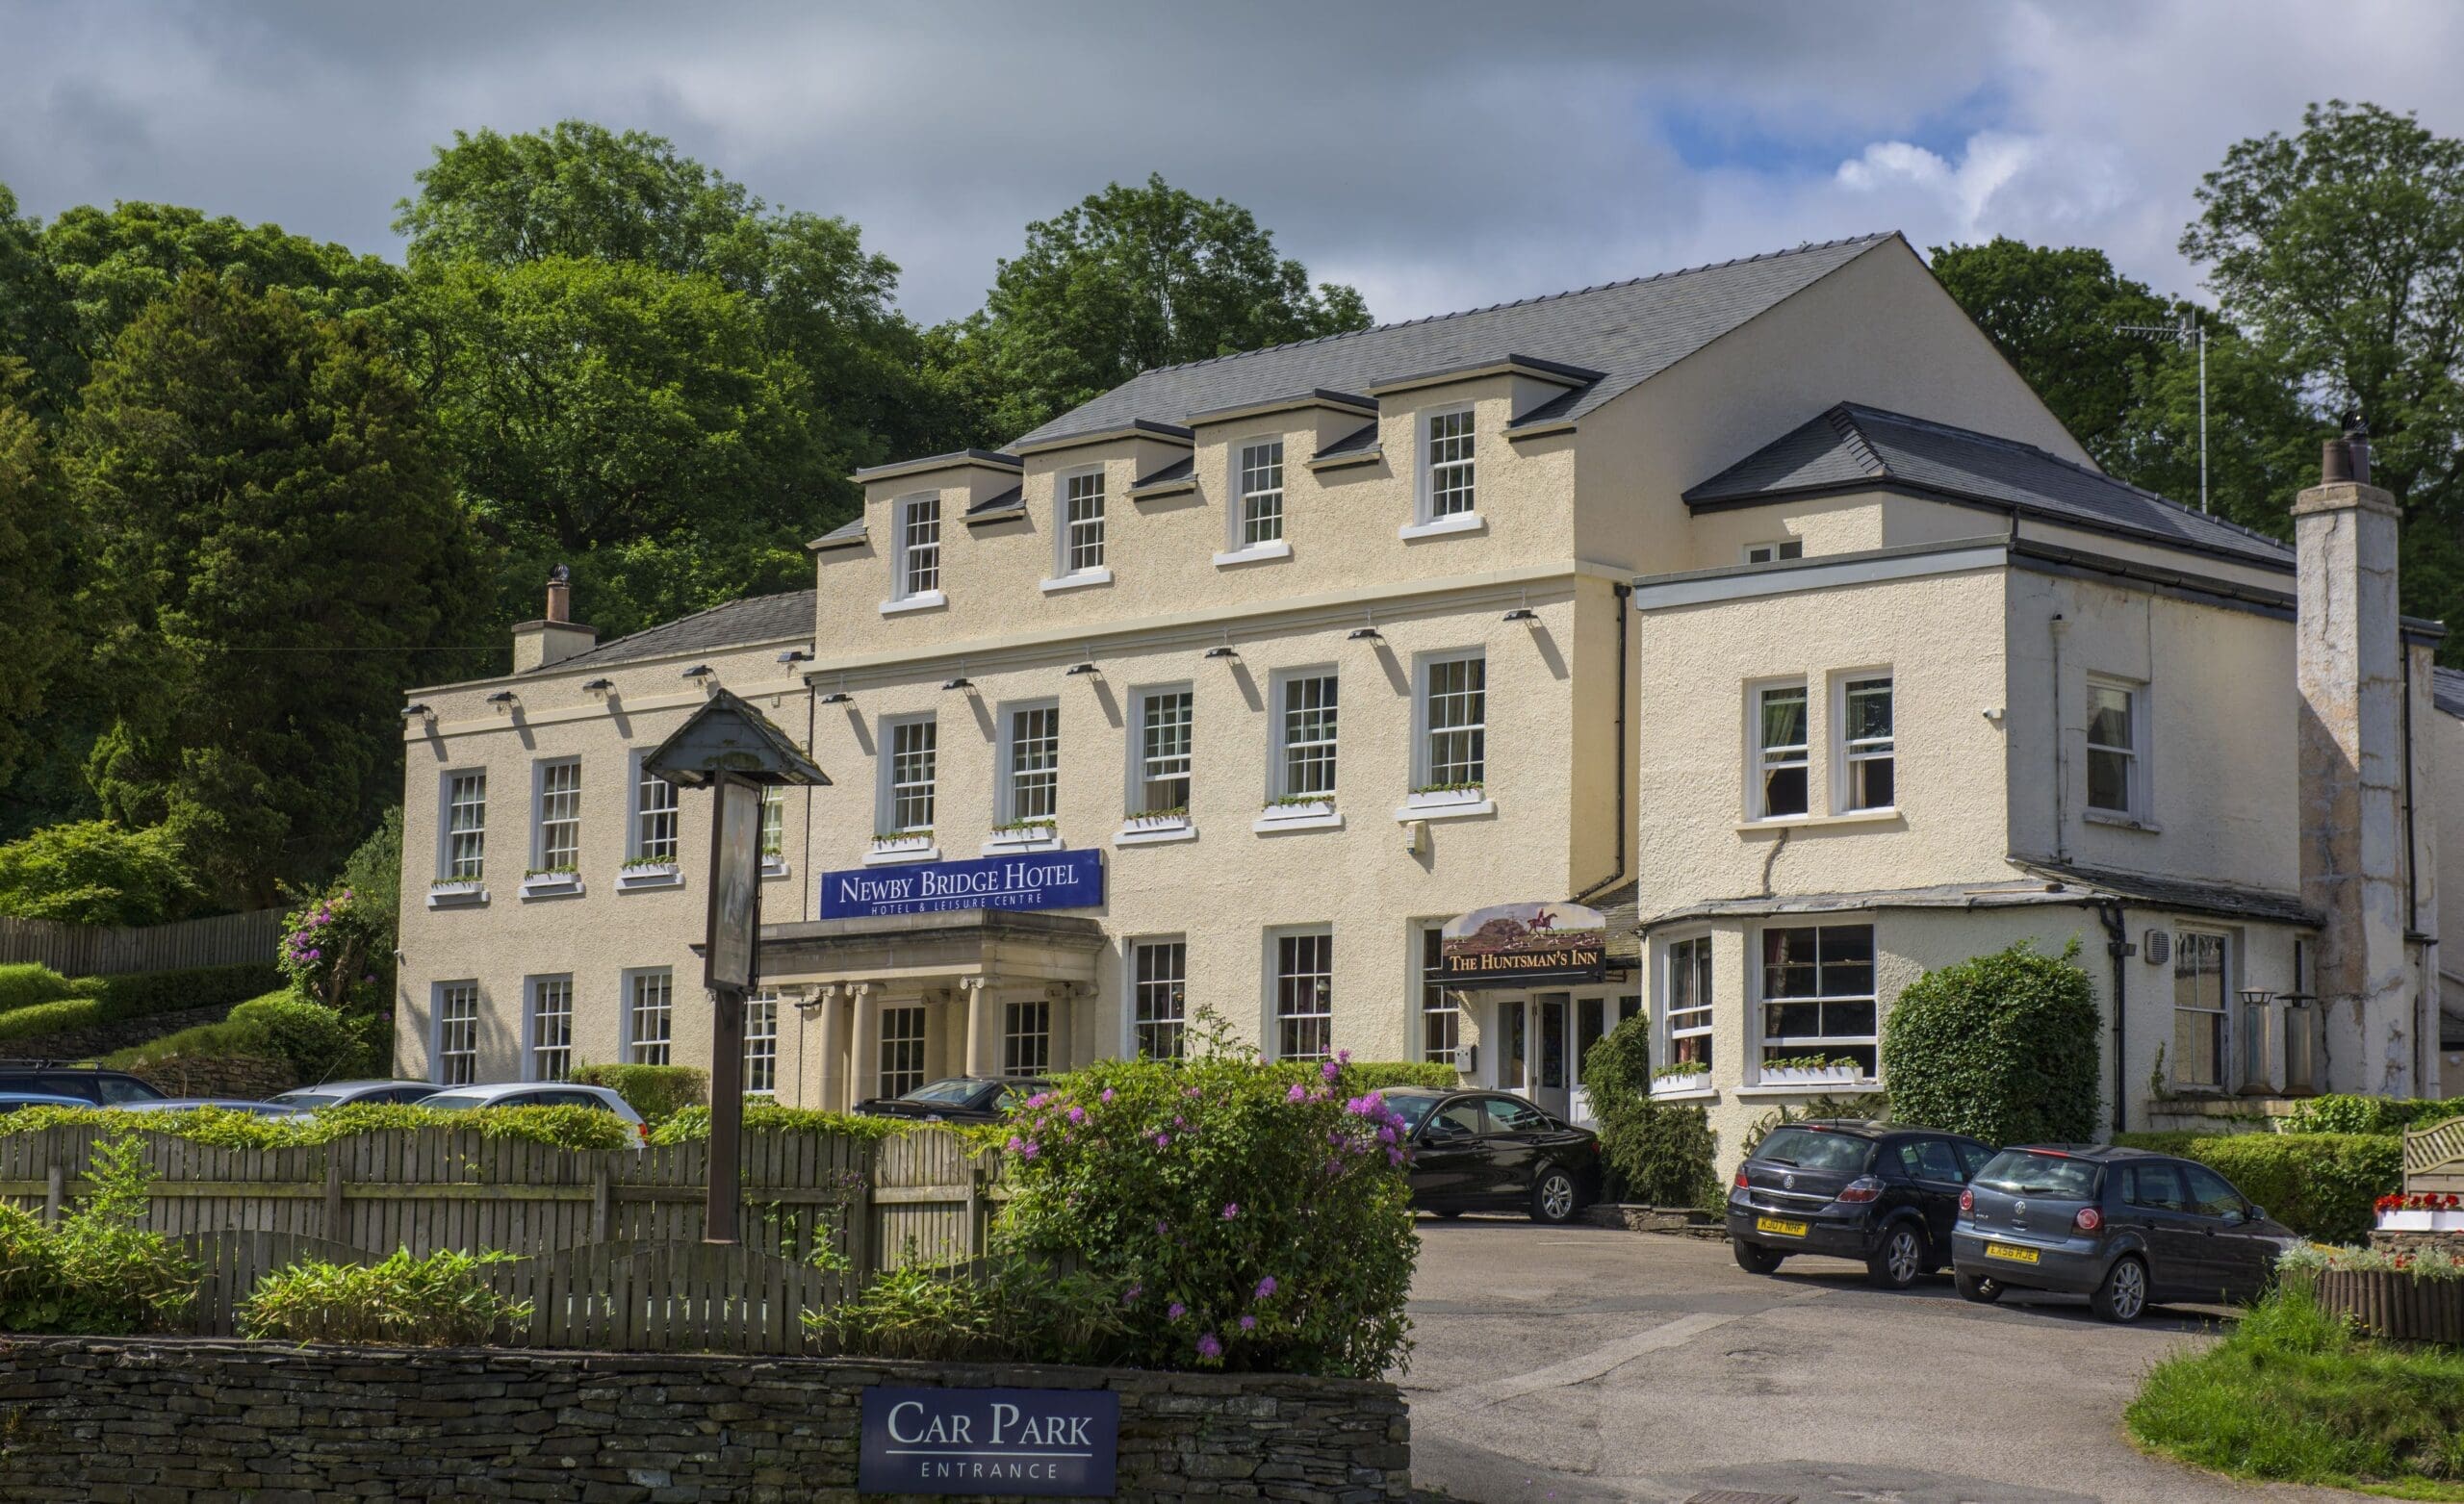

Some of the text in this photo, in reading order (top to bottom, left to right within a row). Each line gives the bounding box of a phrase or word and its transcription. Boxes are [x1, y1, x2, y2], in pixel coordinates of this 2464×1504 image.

[840, 862, 1079, 903] NEWBY BRIDGE HOTEL
[871, 893, 1042, 916] HOTEL & LEISURE CENTRE
[1450, 956, 1477, 972] THE
[1572, 950, 1598, 965] INN
[887, 1401, 1092, 1445] CAR PARK
[921, 1463, 1057, 1479] ENTRANCE
